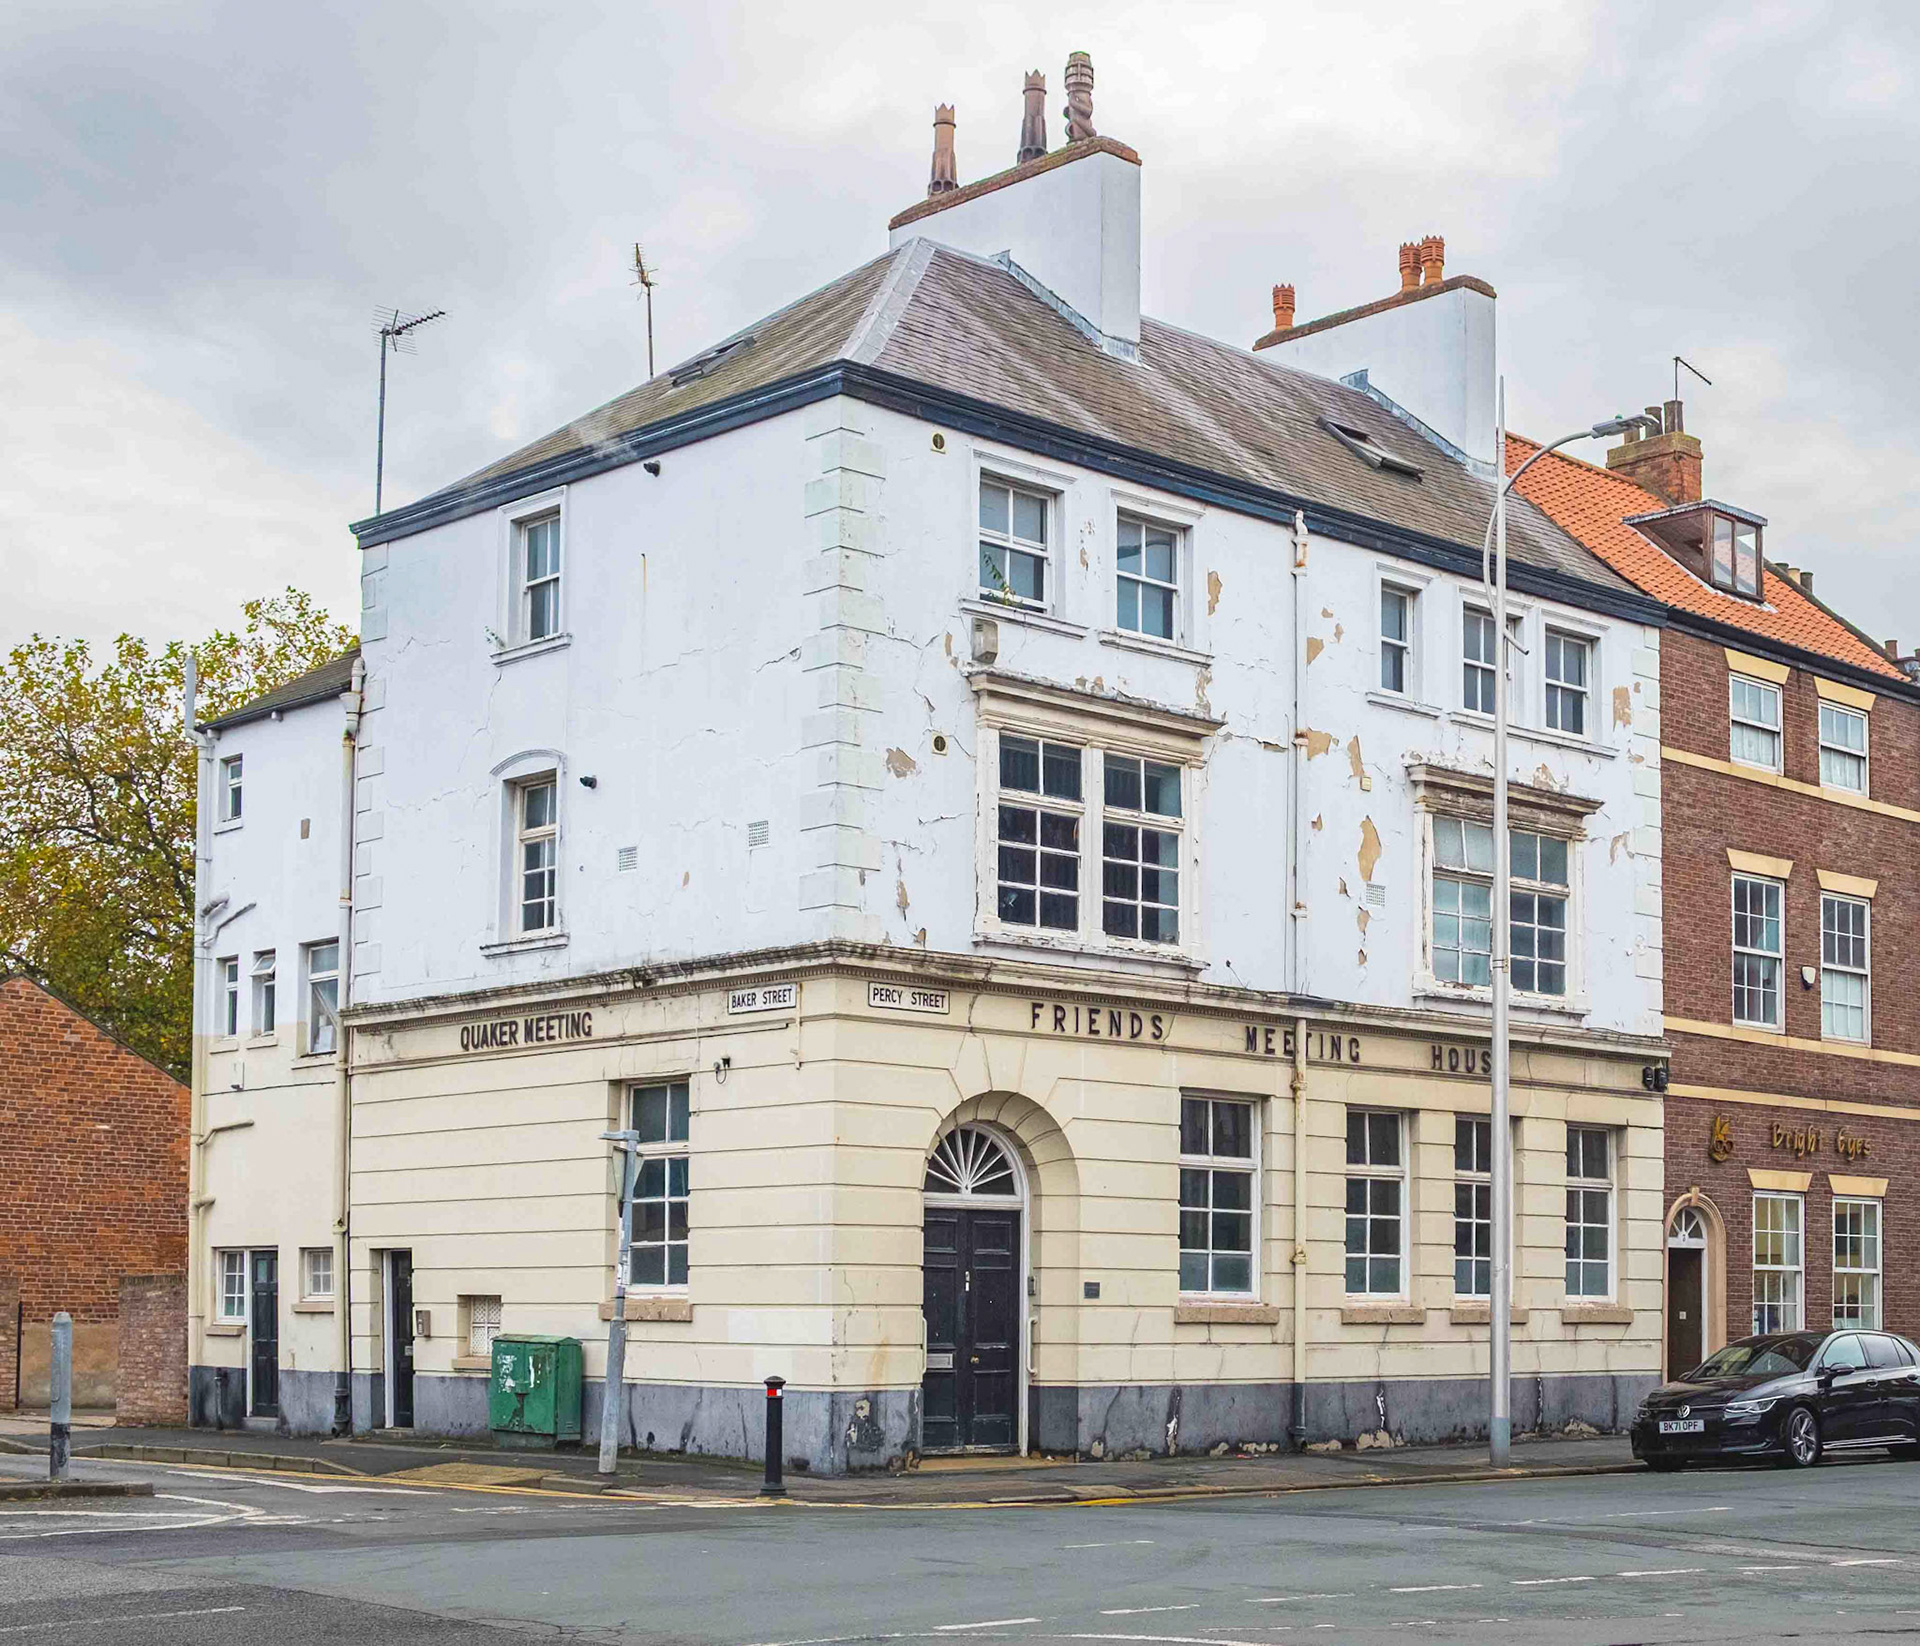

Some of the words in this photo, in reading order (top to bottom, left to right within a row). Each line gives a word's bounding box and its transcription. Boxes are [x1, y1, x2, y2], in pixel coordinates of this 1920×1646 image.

[731, 992, 757, 1009] BAKER
[762, 988, 793, 1005] STREET
[873, 987, 903, 1004] PERCY
[911, 991, 946, 1009] STREET
[460, 1020, 519, 1051] QUAKER
[524, 1011, 593, 1044] MEETING
[1031, 1002, 1163, 1040] FRIENDS
[1431, 1045, 1492, 1074] HOUS
[1663, 1421, 1681, 1432] BK71
[1682, 1421, 1699, 1431] OPF
